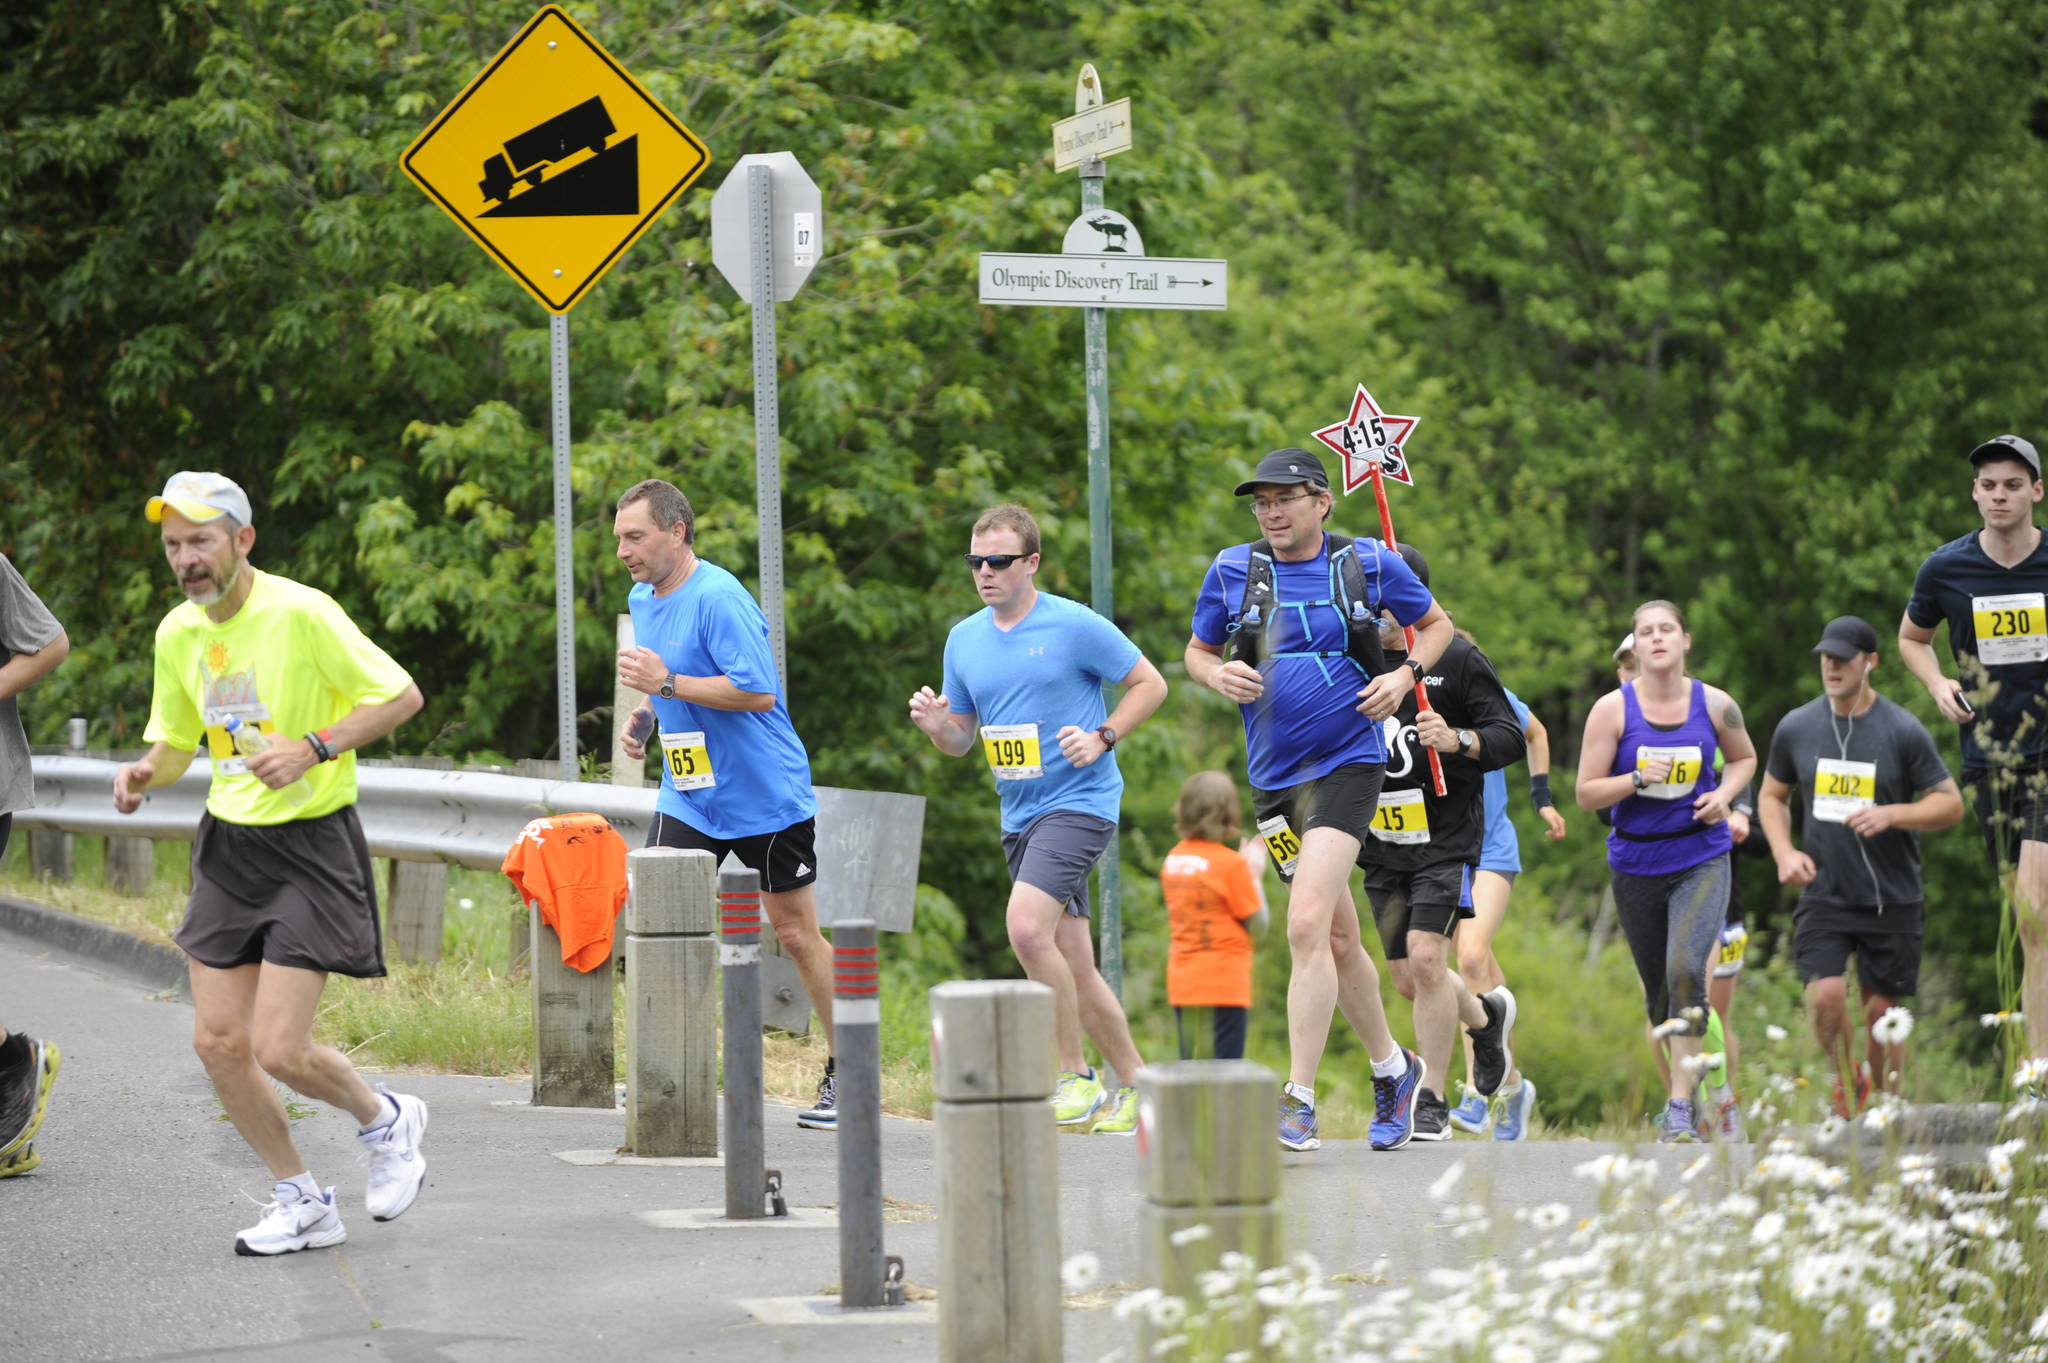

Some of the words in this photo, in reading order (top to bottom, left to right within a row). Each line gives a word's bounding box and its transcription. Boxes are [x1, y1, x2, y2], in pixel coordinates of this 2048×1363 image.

[992, 267, 1051, 292] Olympic
[1055, 269, 1123, 294] Discovery
[1127, 271, 1158, 291] Trail
[1343, 417, 1386, 454] 4:15
[1991, 609, 2030, 636] 230
[992, 740, 1025, 766] 199
[1829, 773, 1860, 796] 202
[1380, 806, 1405, 831] 15
[1268, 831, 1300, 862] 56
